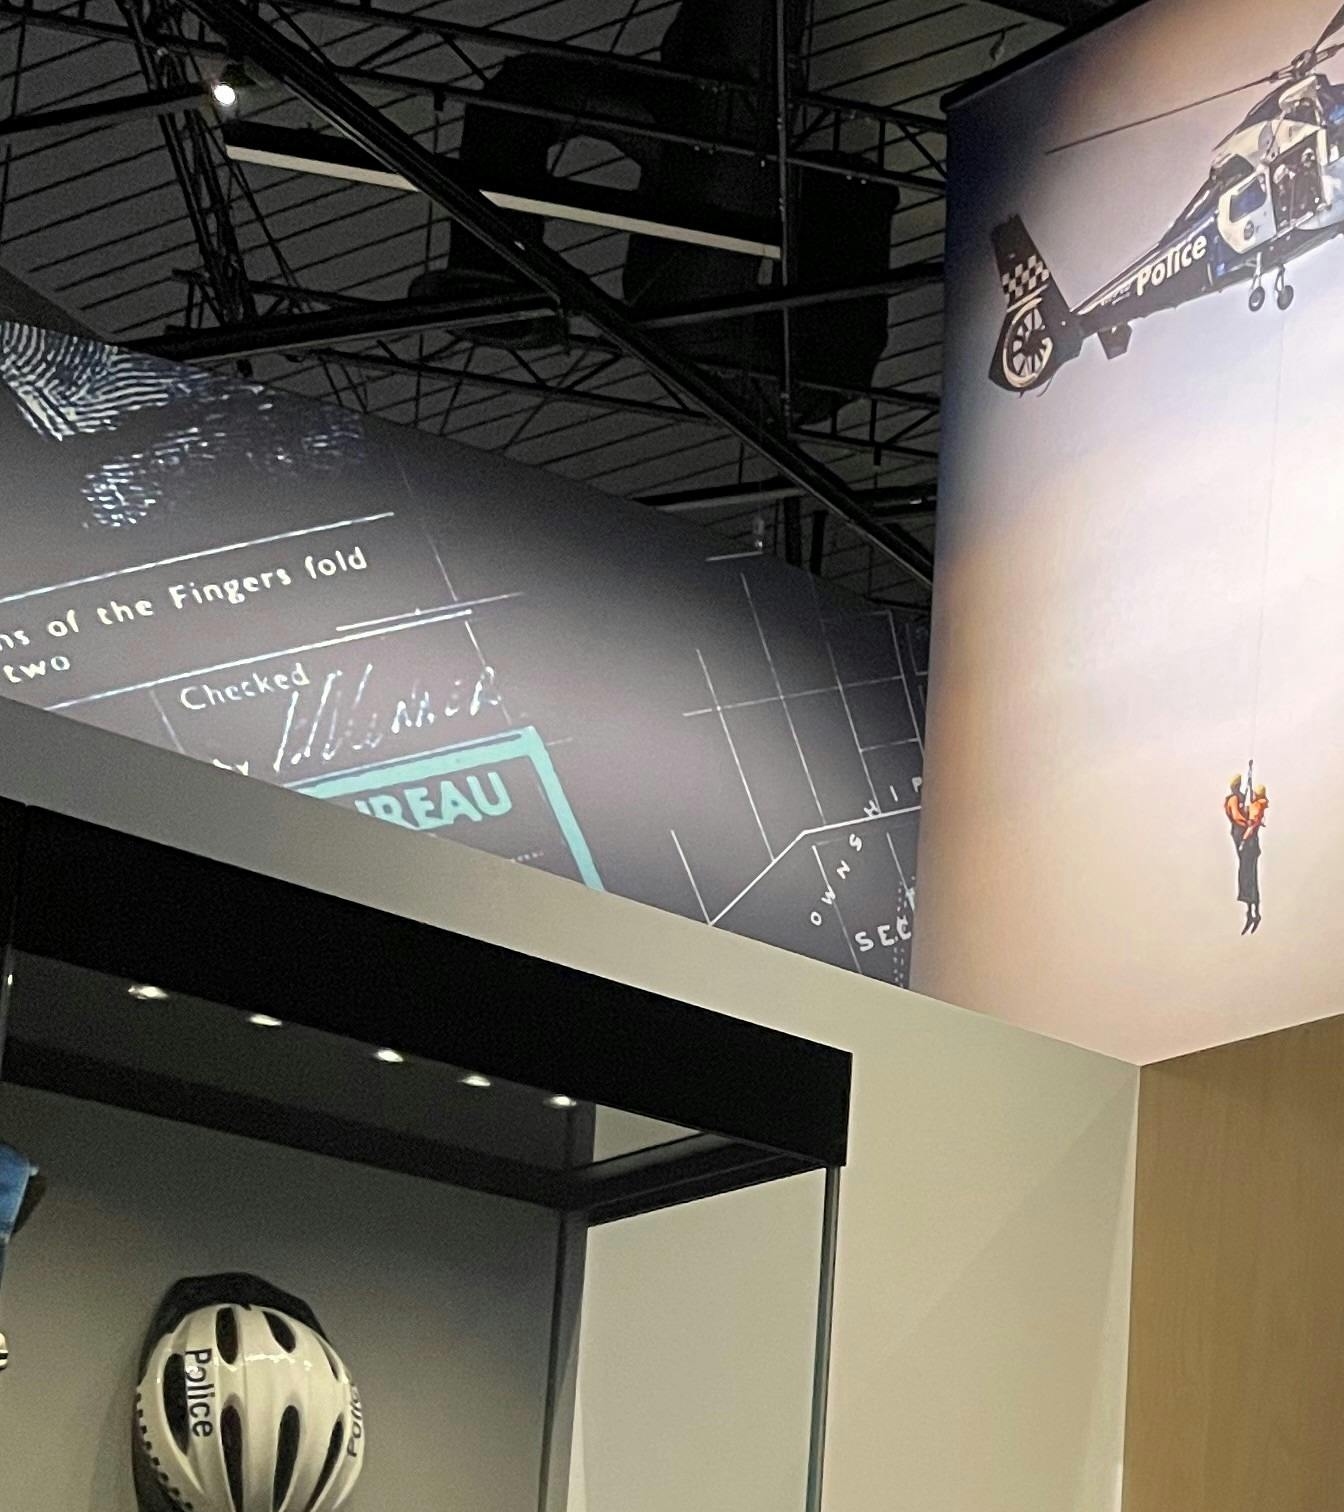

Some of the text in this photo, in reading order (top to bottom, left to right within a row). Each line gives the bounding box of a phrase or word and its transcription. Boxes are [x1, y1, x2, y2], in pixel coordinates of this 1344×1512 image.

[1136, 235, 1207, 297] Police
[47, 609, 80, 638] of
[97, 598, 154, 627] the
[168, 566, 292, 611] Fingers
[304, 546, 368, 579] fold
[3, 655, 71, 684] two
[180, 662, 311, 711] Checked
[354, 771, 513, 831] REAU
[185, 1348, 216, 1438] Police
